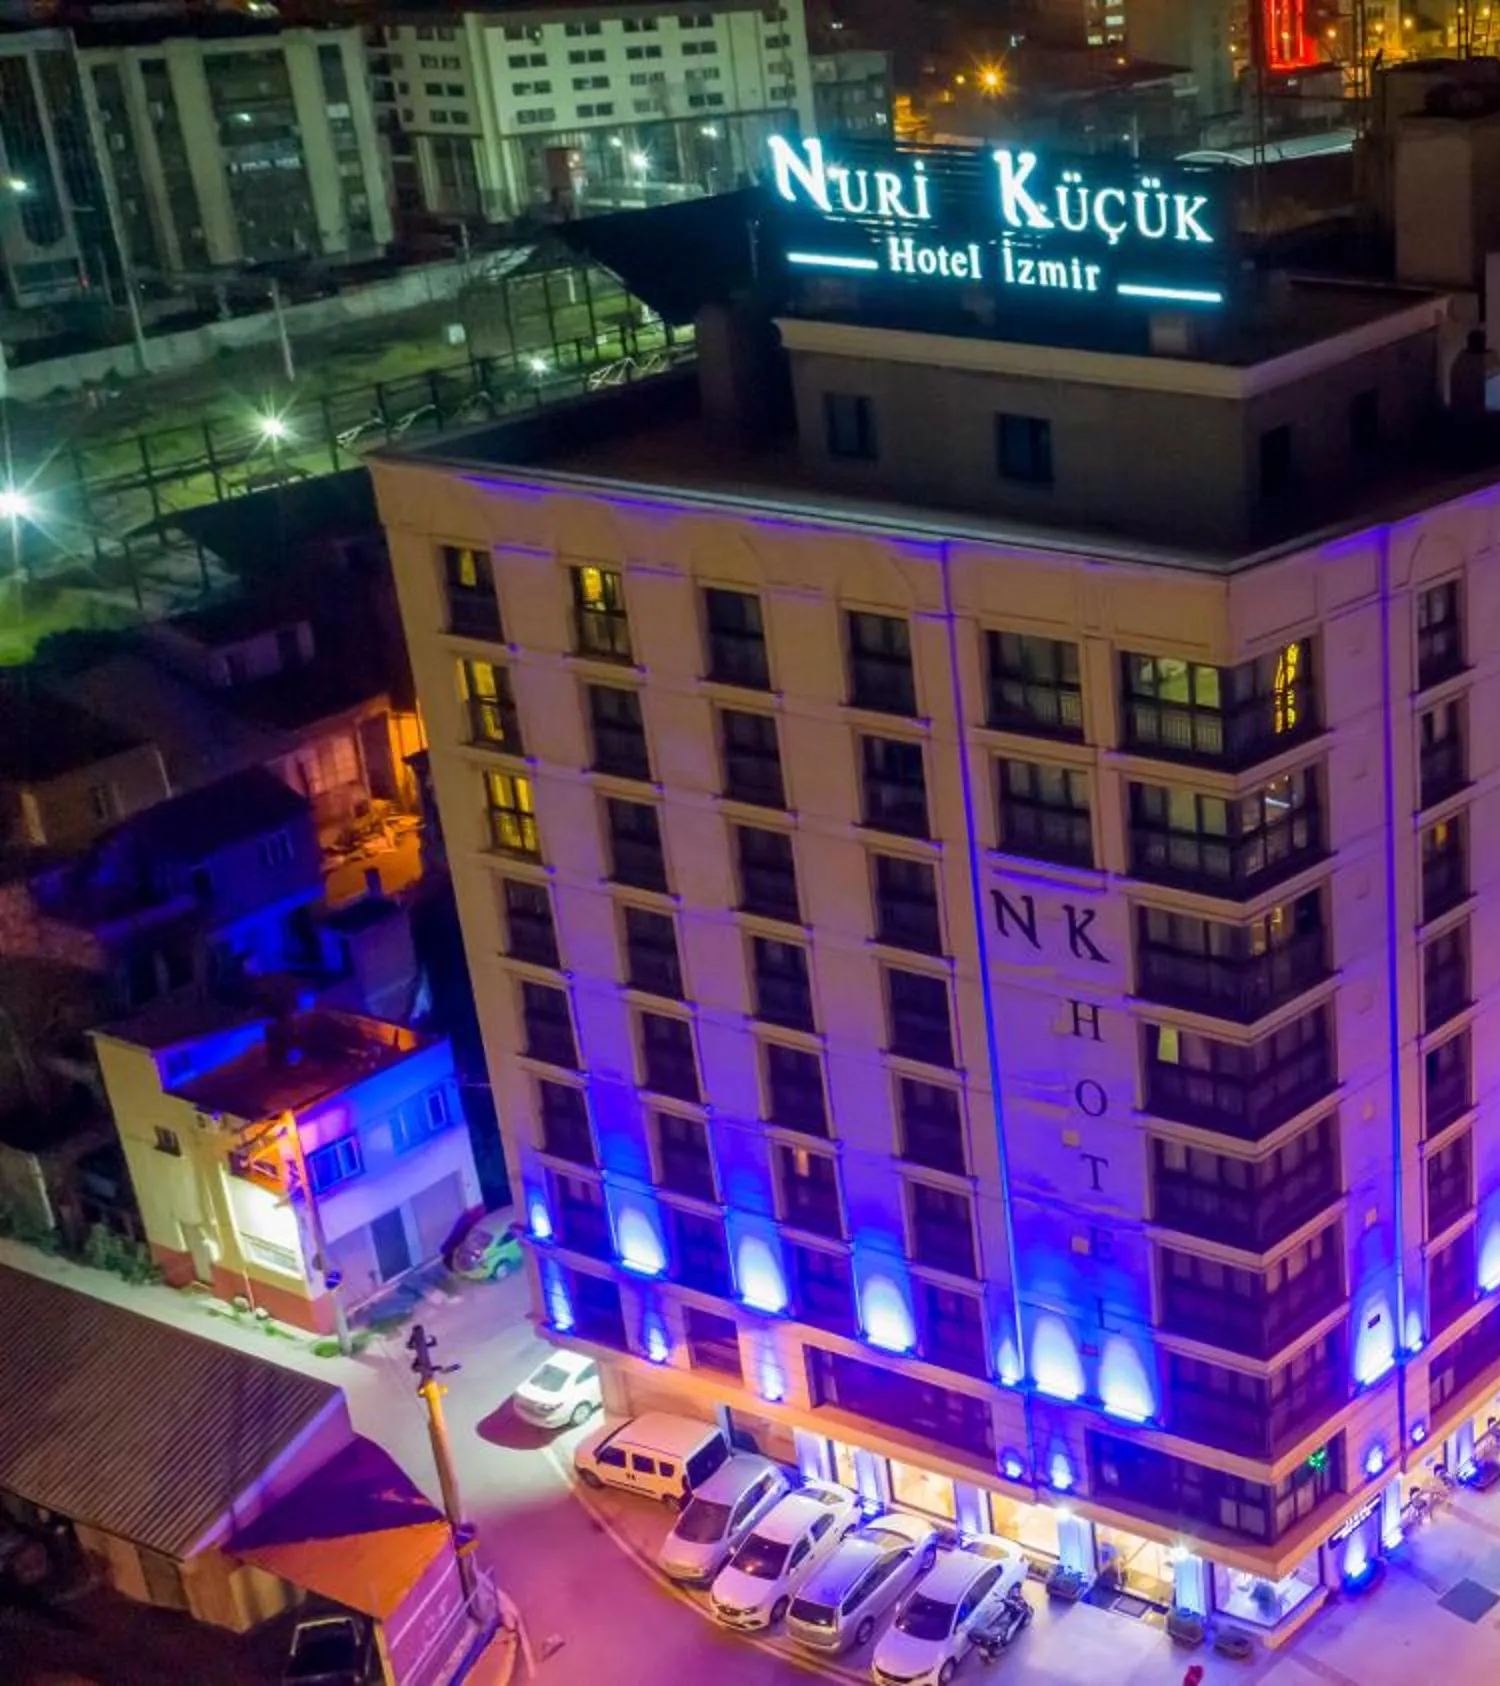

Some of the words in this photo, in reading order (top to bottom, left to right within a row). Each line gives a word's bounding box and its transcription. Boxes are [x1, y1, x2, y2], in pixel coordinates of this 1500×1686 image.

[993, 150, 1214, 243] KÜÇÜK
[888, 237, 982, 279] Hotel
[1003, 239, 1101, 292] İzmir
[1066, 999, 1121, 1334] HOTEL
